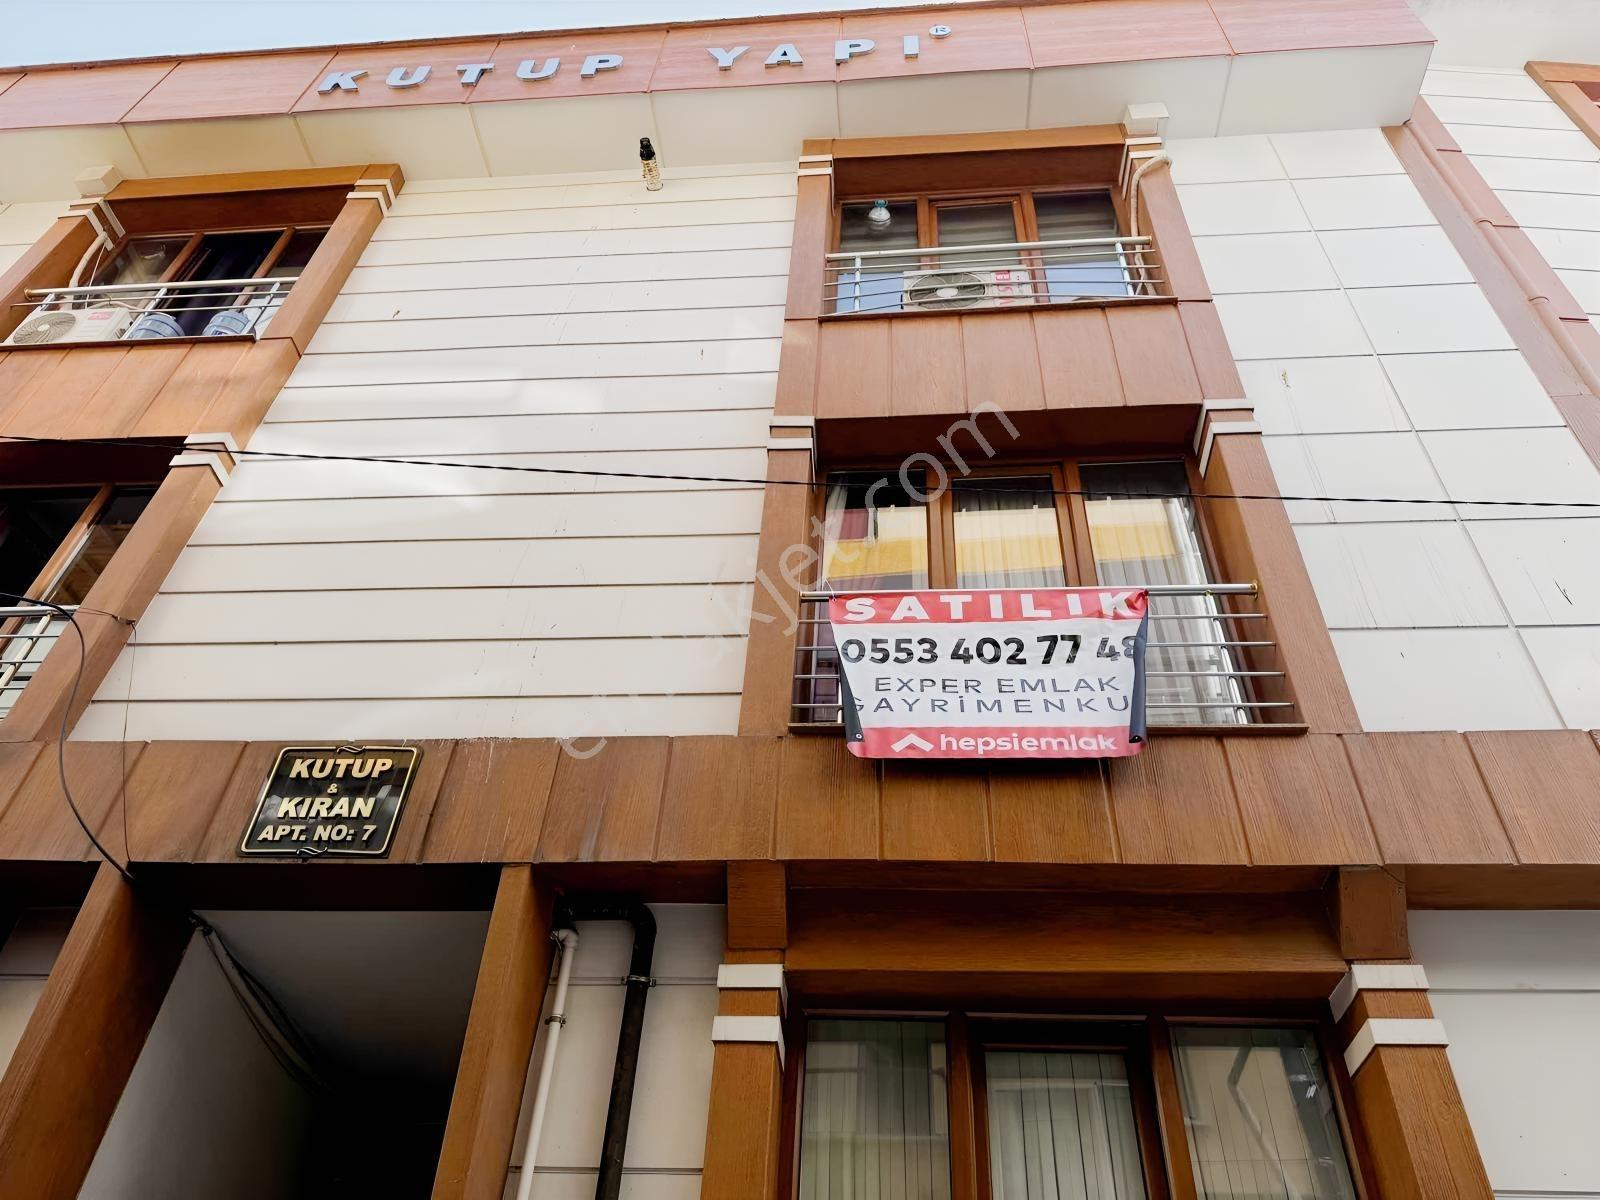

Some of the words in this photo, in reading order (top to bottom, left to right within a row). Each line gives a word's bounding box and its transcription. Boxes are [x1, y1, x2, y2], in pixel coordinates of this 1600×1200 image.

[317, 54, 624, 95] KUTUP
[843, 592, 1137, 622] SATILIK
[842, 638, 939, 664] 0553
[950, 638, 1028, 665] 402
[1036, 634, 1082, 664] 77
[874, 677, 982, 694] EXPER
[997, 676, 1121, 694] EMLAK
[940, 734, 1119, 755] hepsiemlak
[289, 758, 393, 779] KUTUP
[327, 783, 338, 794] &
[276, 797, 376, 819] KIRAN
[256, 825, 306, 841] APT.
[312, 825, 355, 841] NO:
[361, 825, 378, 841] 7
